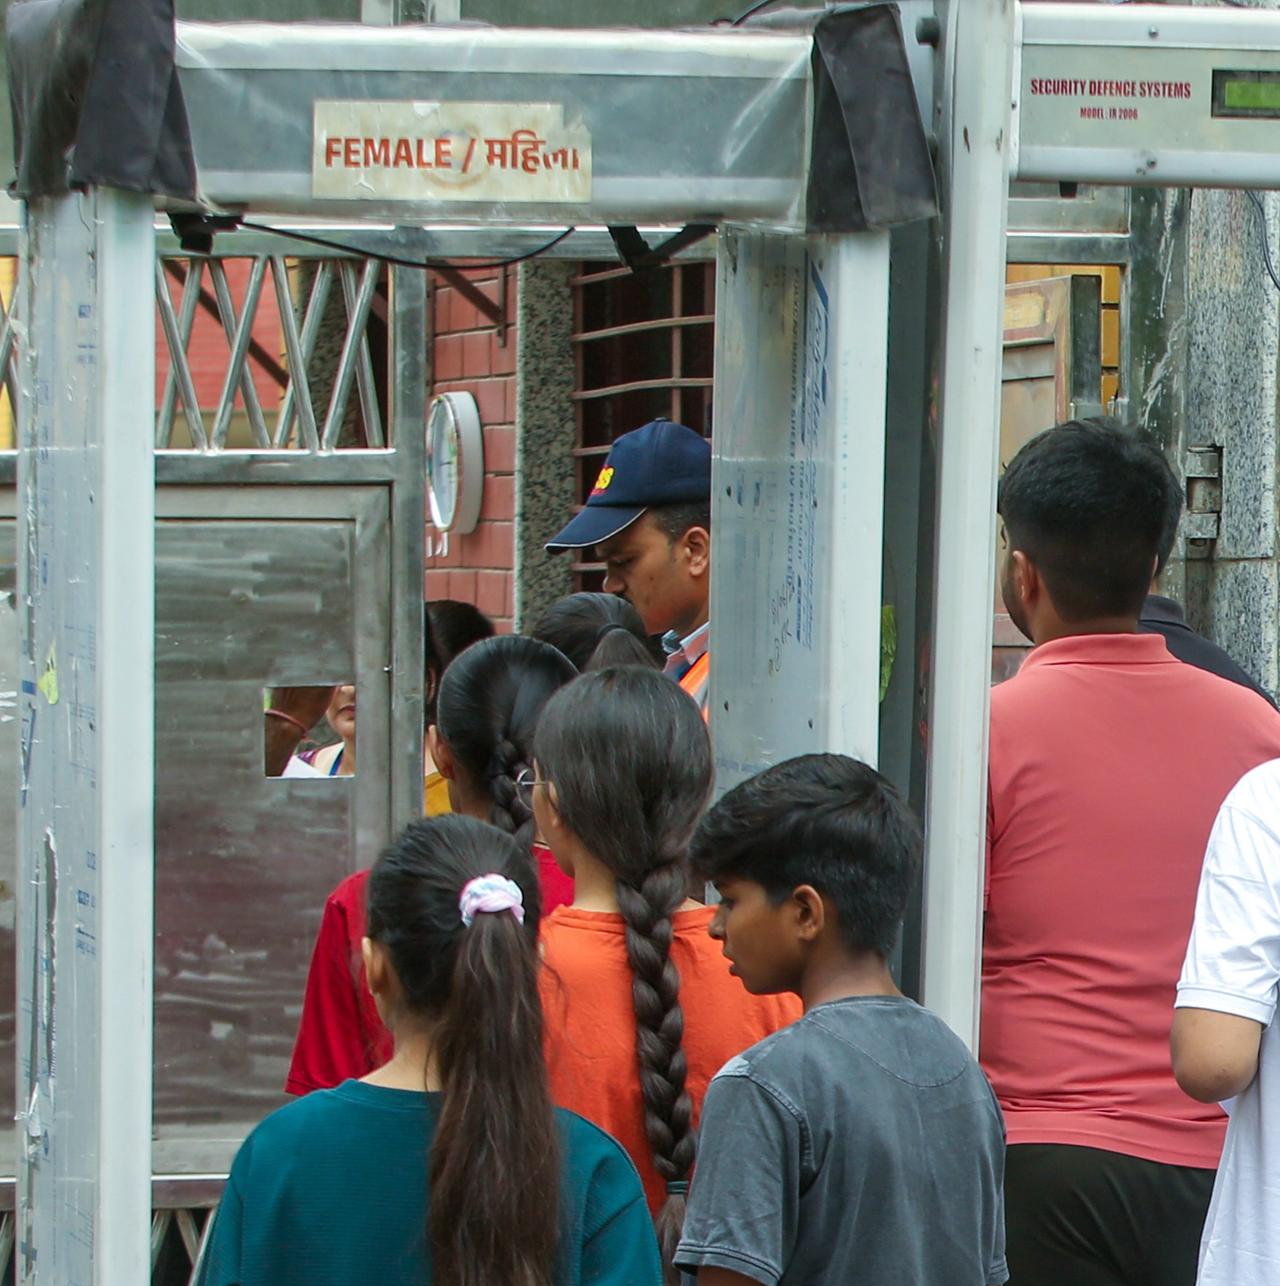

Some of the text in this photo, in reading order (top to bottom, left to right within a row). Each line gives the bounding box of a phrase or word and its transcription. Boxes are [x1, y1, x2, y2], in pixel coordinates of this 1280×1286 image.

[1030, 78, 1192, 100] SECURITY DEFENCE SYSTEMS
[1079, 106, 1104, 120] MODEL
[1118, 108, 1138, 121] 2006
[324, 136, 477, 175] FEMALE /
